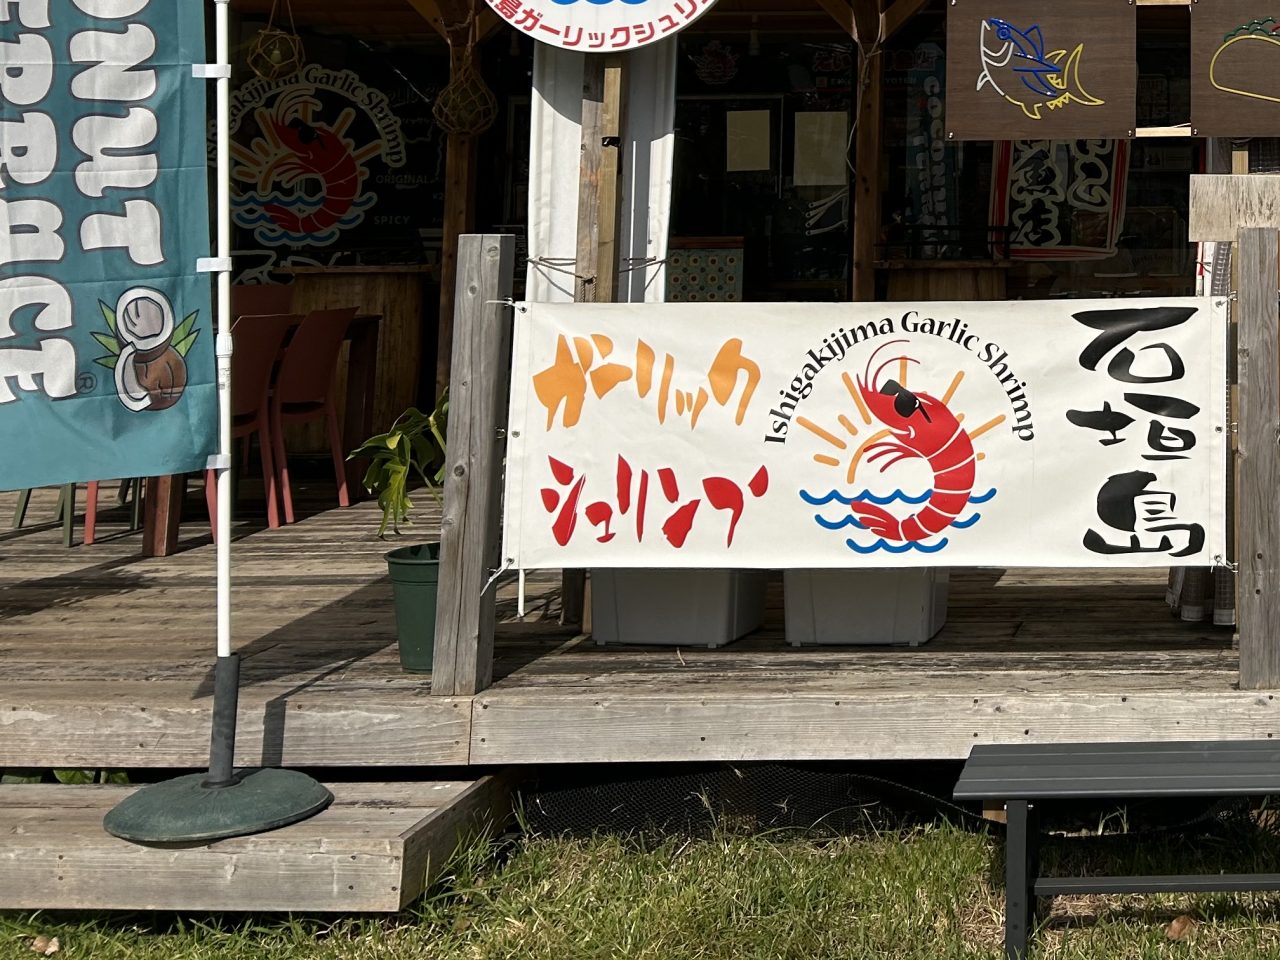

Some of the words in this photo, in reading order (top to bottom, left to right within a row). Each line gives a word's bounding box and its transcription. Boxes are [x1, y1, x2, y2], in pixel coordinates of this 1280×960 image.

[305, 67, 363, 97] Garlic
[363, 92, 403, 163] Shrimp
[533, 333, 763, 431] ガーリック
[764, 317, 895, 445] Ishigakijima
[900, 310, 980, 352] Garlic
[977, 341, 1035, 442] Shrimp
[1066, 306, 1206, 558] 石垣島
[540, 453, 769, 548] シュリンプ
